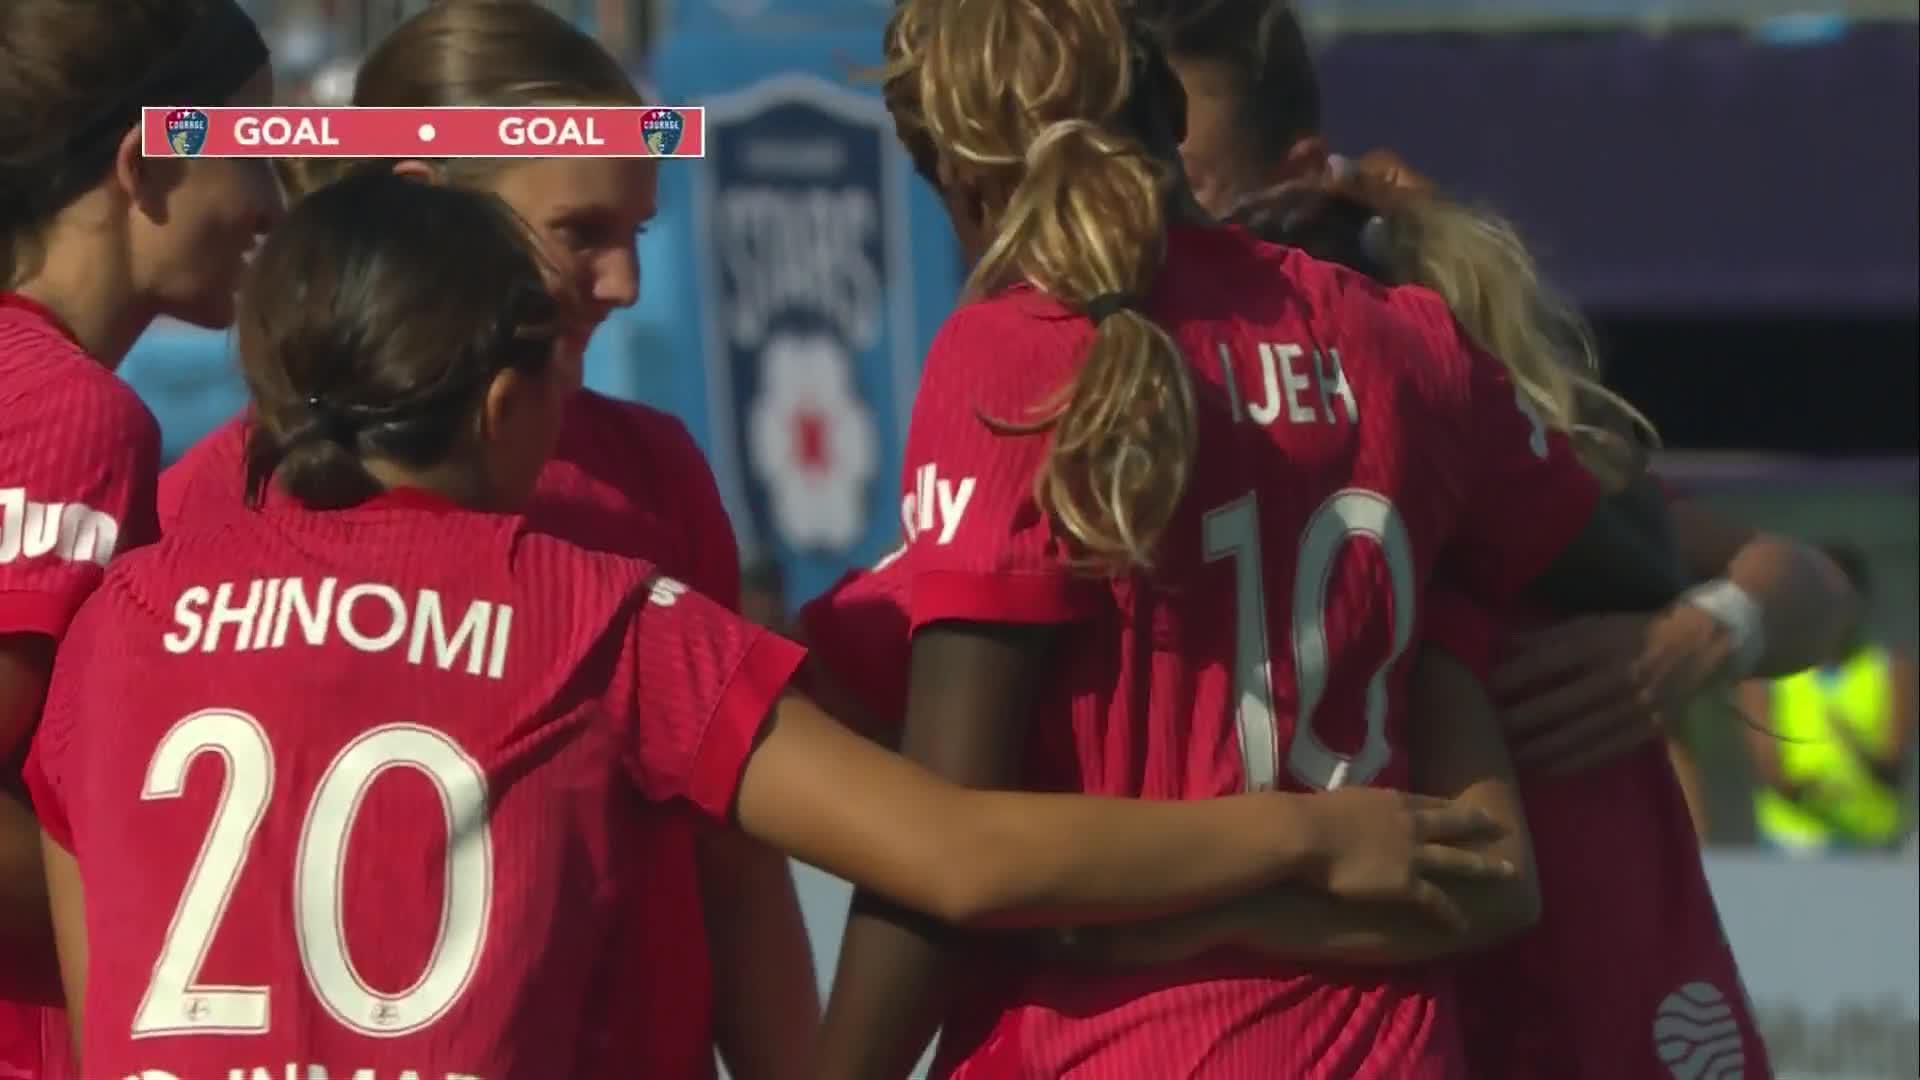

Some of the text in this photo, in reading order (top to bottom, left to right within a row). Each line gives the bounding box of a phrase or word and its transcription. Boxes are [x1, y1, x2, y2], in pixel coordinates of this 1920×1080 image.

[1217, 343, 1359, 425] IJEH
[163, 576, 513, 679] SHINOMI
[1202, 489, 1416, 793] 10
[131, 708, 494, 1039] 20
